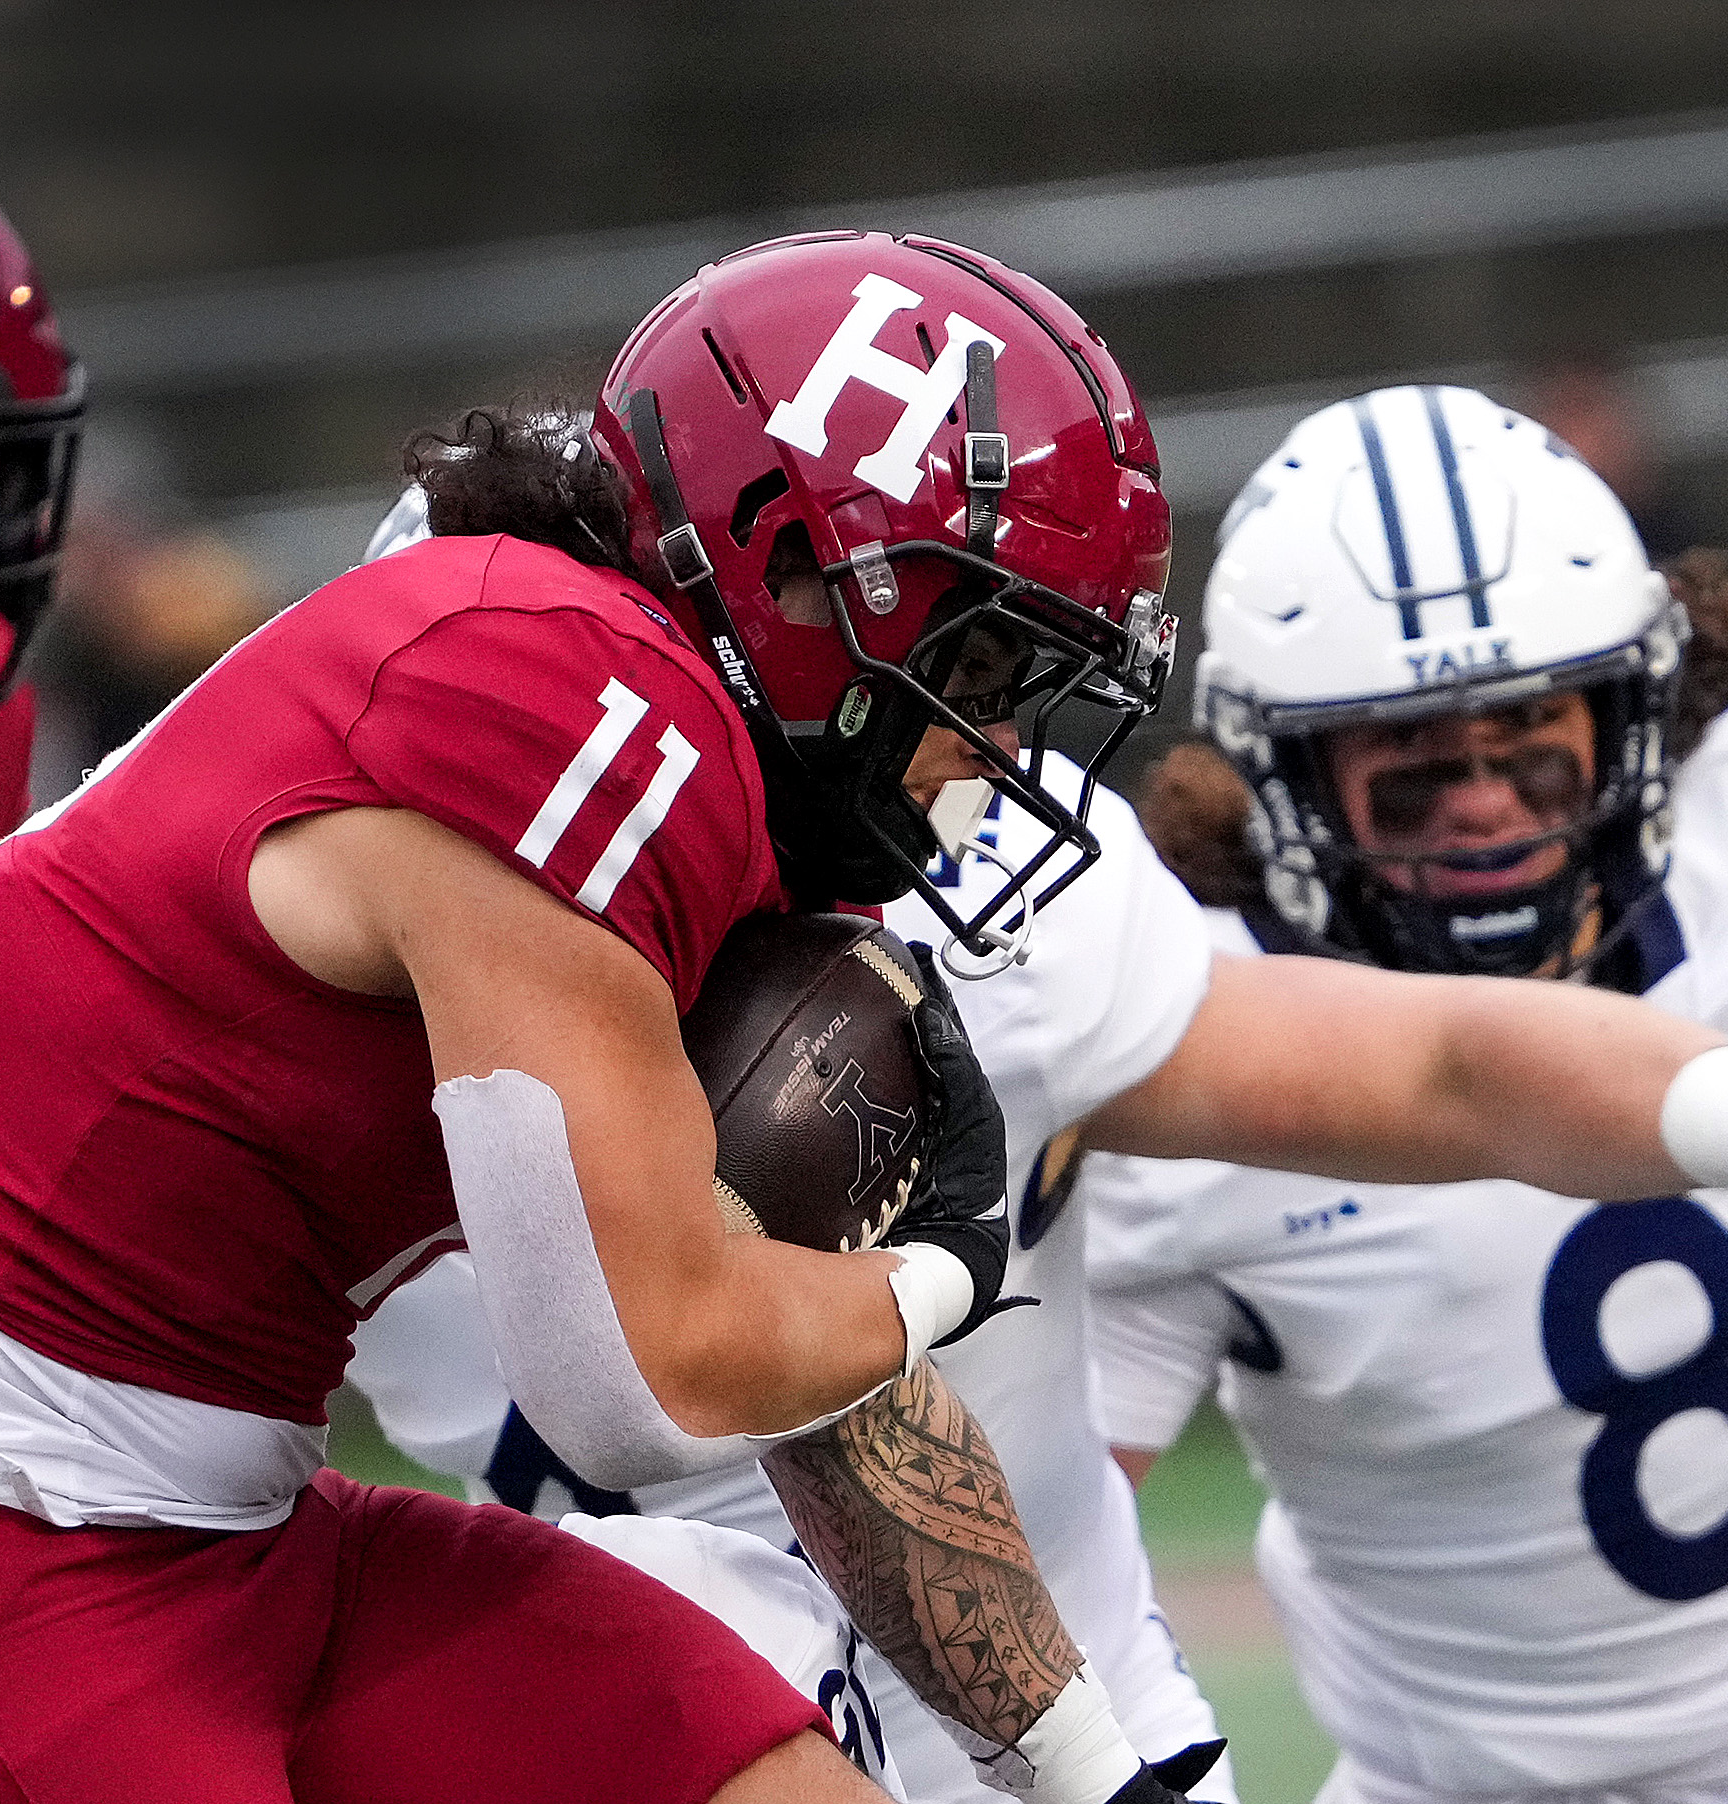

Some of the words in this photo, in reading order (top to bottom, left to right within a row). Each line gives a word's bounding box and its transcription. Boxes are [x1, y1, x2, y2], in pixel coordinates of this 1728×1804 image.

[764, 272, 1007, 504] H
[515, 676, 702, 915] 11
[773, 1053, 814, 1121] ISSUE
[811, 1011, 852, 1057] TEAM
